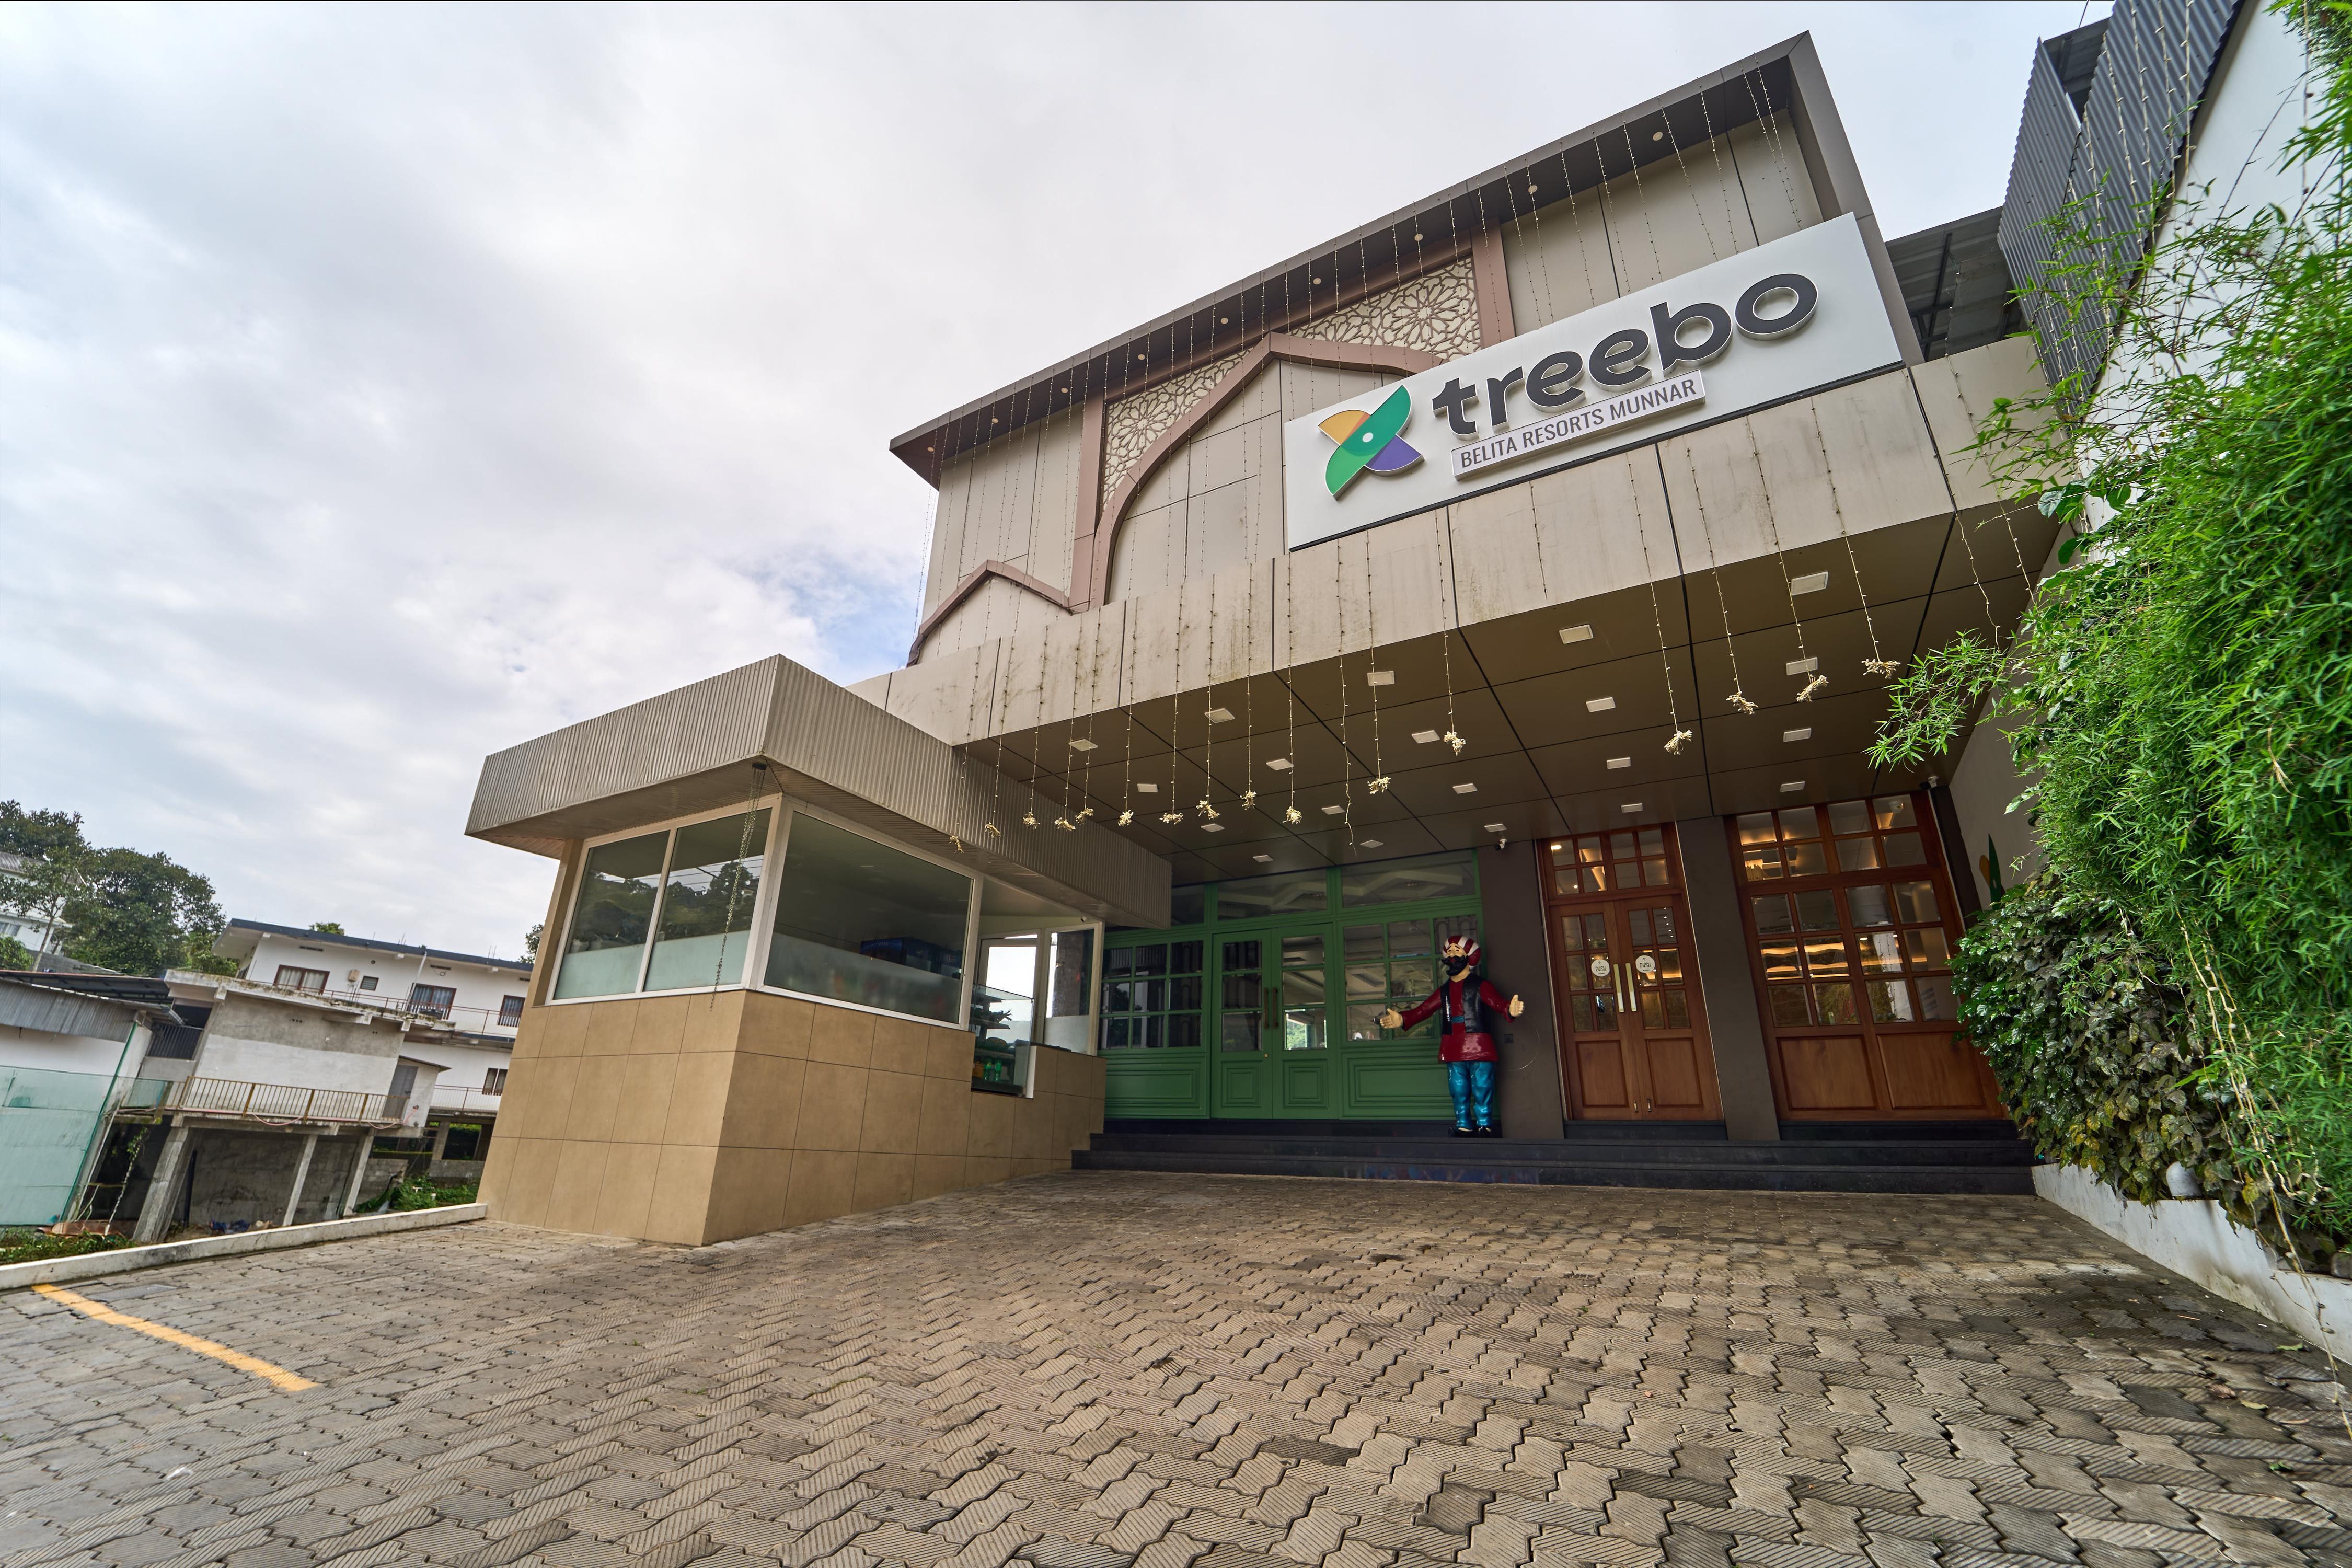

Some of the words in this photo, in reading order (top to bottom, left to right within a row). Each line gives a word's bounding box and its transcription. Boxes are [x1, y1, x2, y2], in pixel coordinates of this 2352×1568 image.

[1432, 273, 1818, 438] treebo
[1461, 437, 1517, 468] BELITA
[1523, 408, 1604, 448] RESORTS
[1609, 379, 1697, 420] MUNNAR
